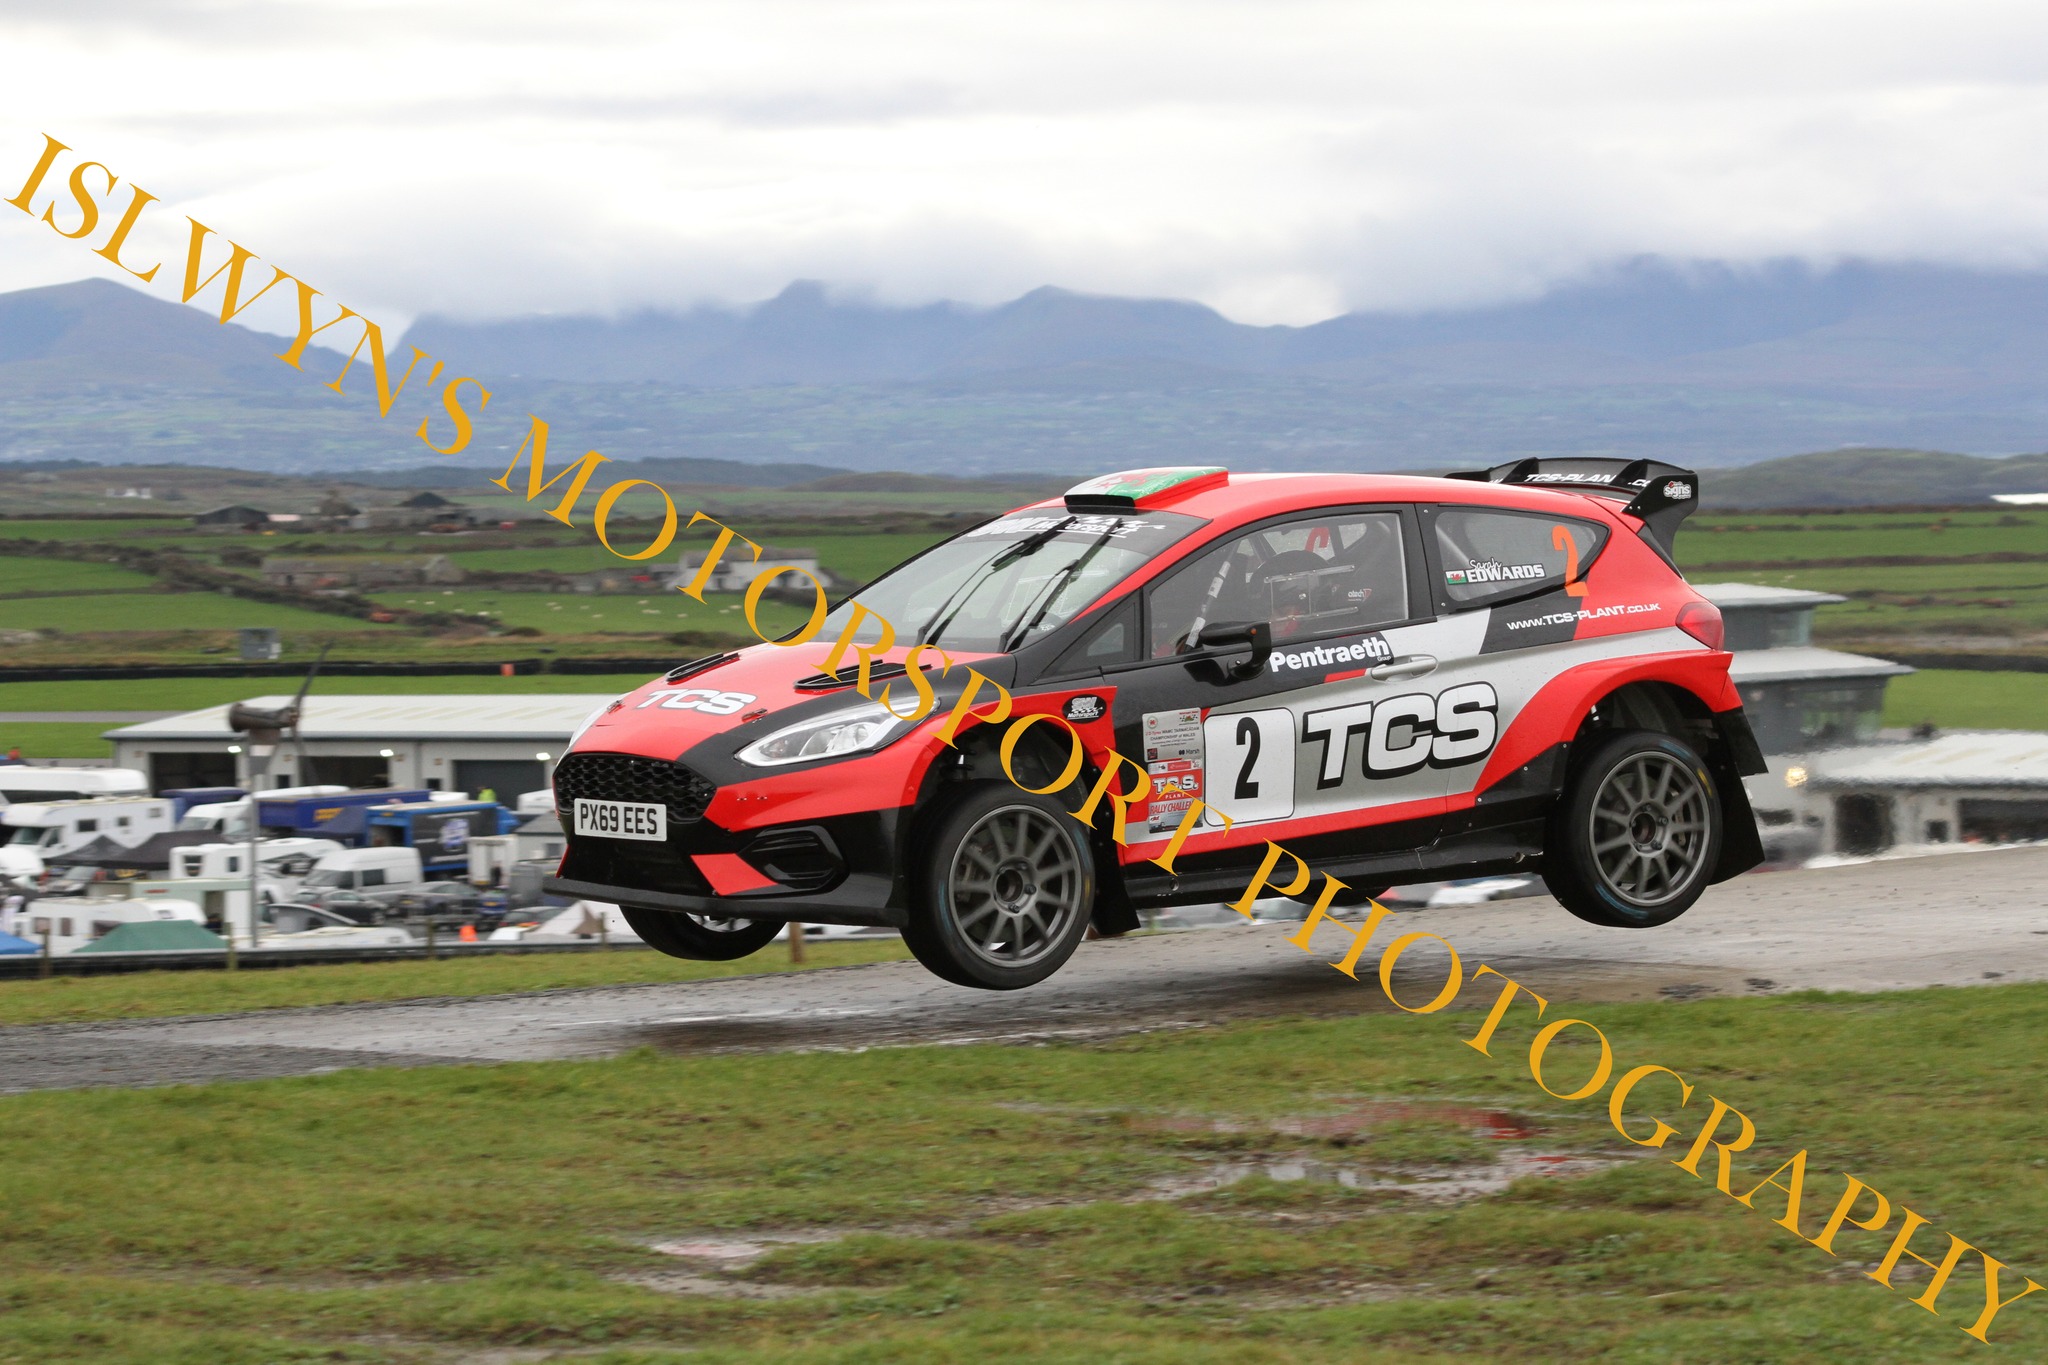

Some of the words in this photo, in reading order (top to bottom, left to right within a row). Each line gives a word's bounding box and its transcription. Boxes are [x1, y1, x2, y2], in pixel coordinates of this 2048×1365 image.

[1466, 564, 1545, 583] EDWARDS
[1469, 557, 1502, 571] Sarah
[1552, 525, 1590, 597] 2
[1269, 637, 1390, 673] Pentraeth
[635, 688, 757, 716] TCS
[1302, 681, 1499, 790] TCS
[1234, 717, 1261, 800] 2
[580, 802, 619, 833] PX69
[623, 806, 658, 835] EES
